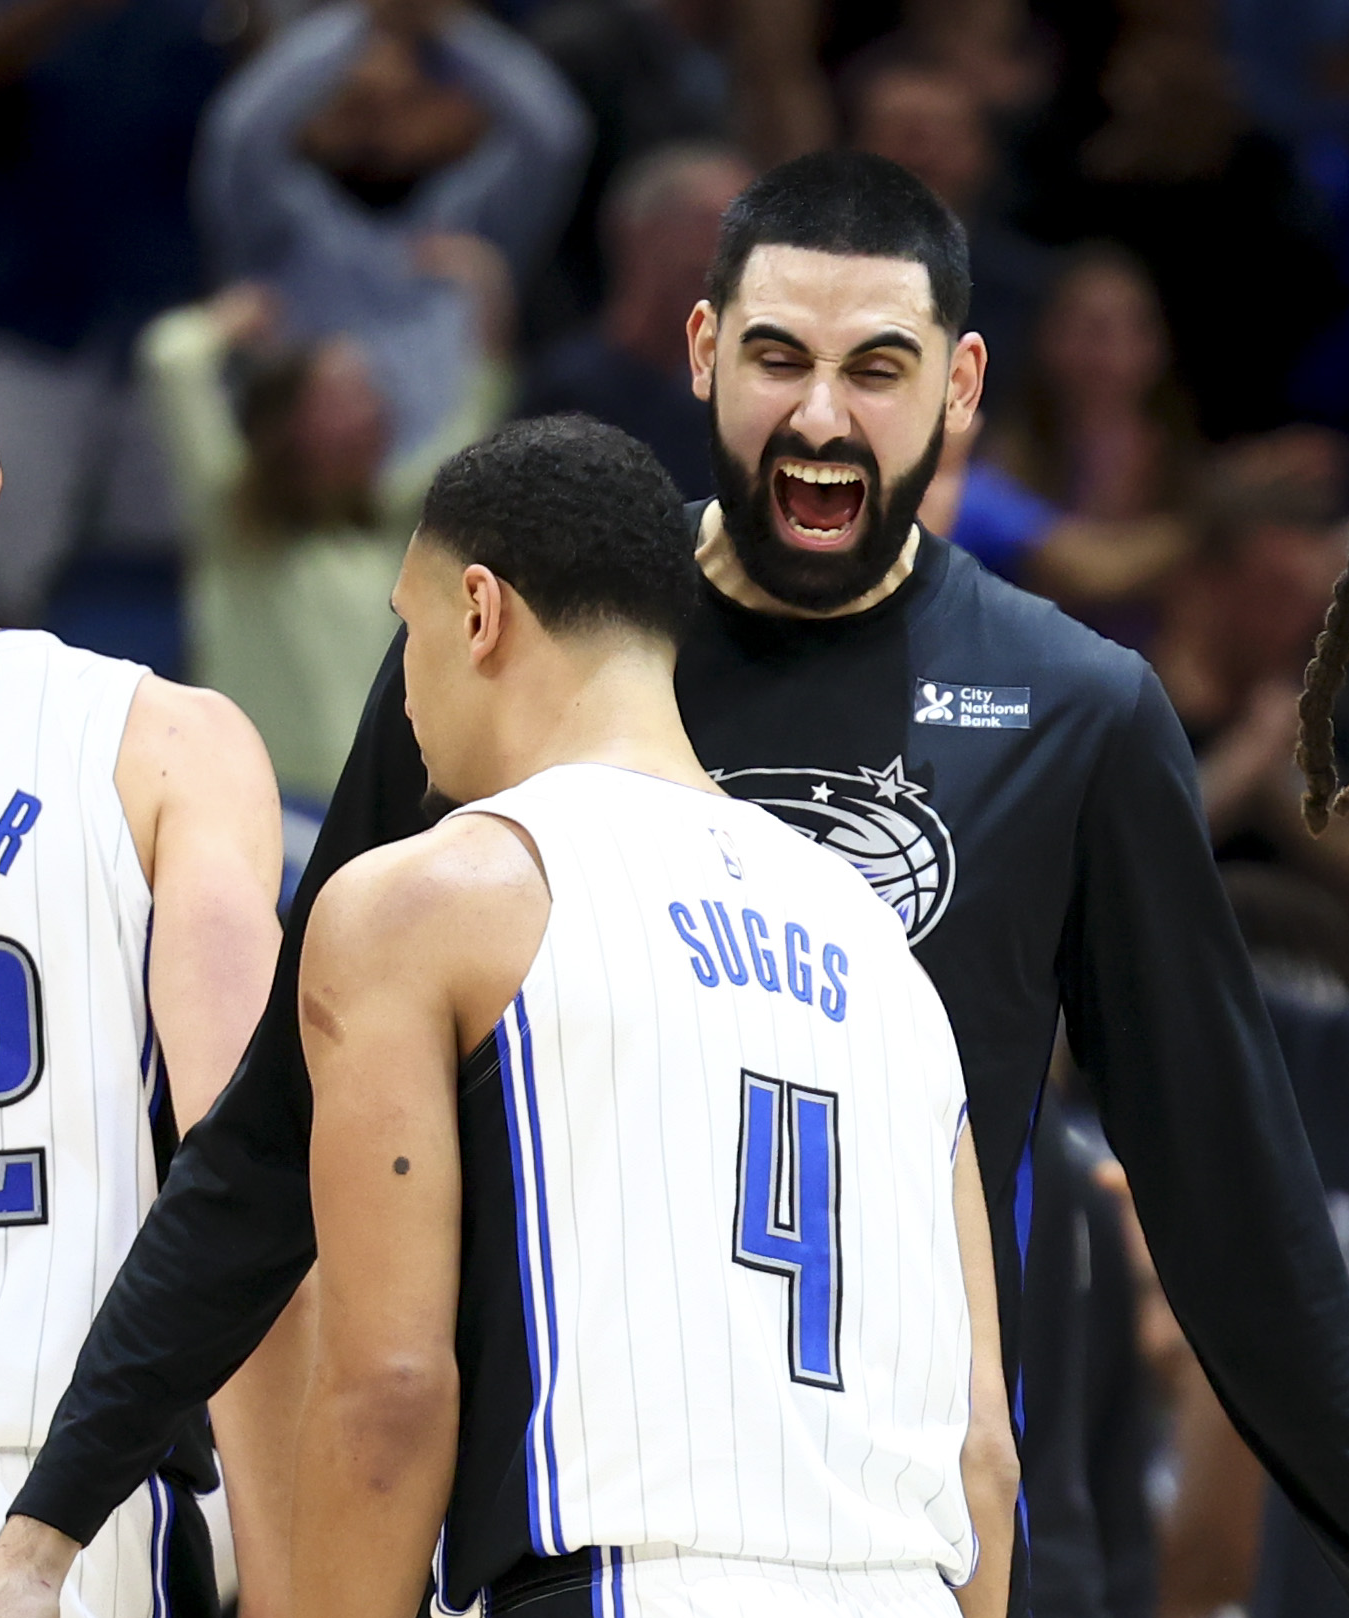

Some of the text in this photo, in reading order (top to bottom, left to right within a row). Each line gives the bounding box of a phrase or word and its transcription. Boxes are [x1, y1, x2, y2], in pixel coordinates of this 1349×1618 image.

[960, 687, 993, 704] City
[960, 701, 1029, 715] National
[960, 714, 1002, 727] Bank
[668, 900, 849, 1023] SUGGS
[732, 1067, 845, 1392] 4
